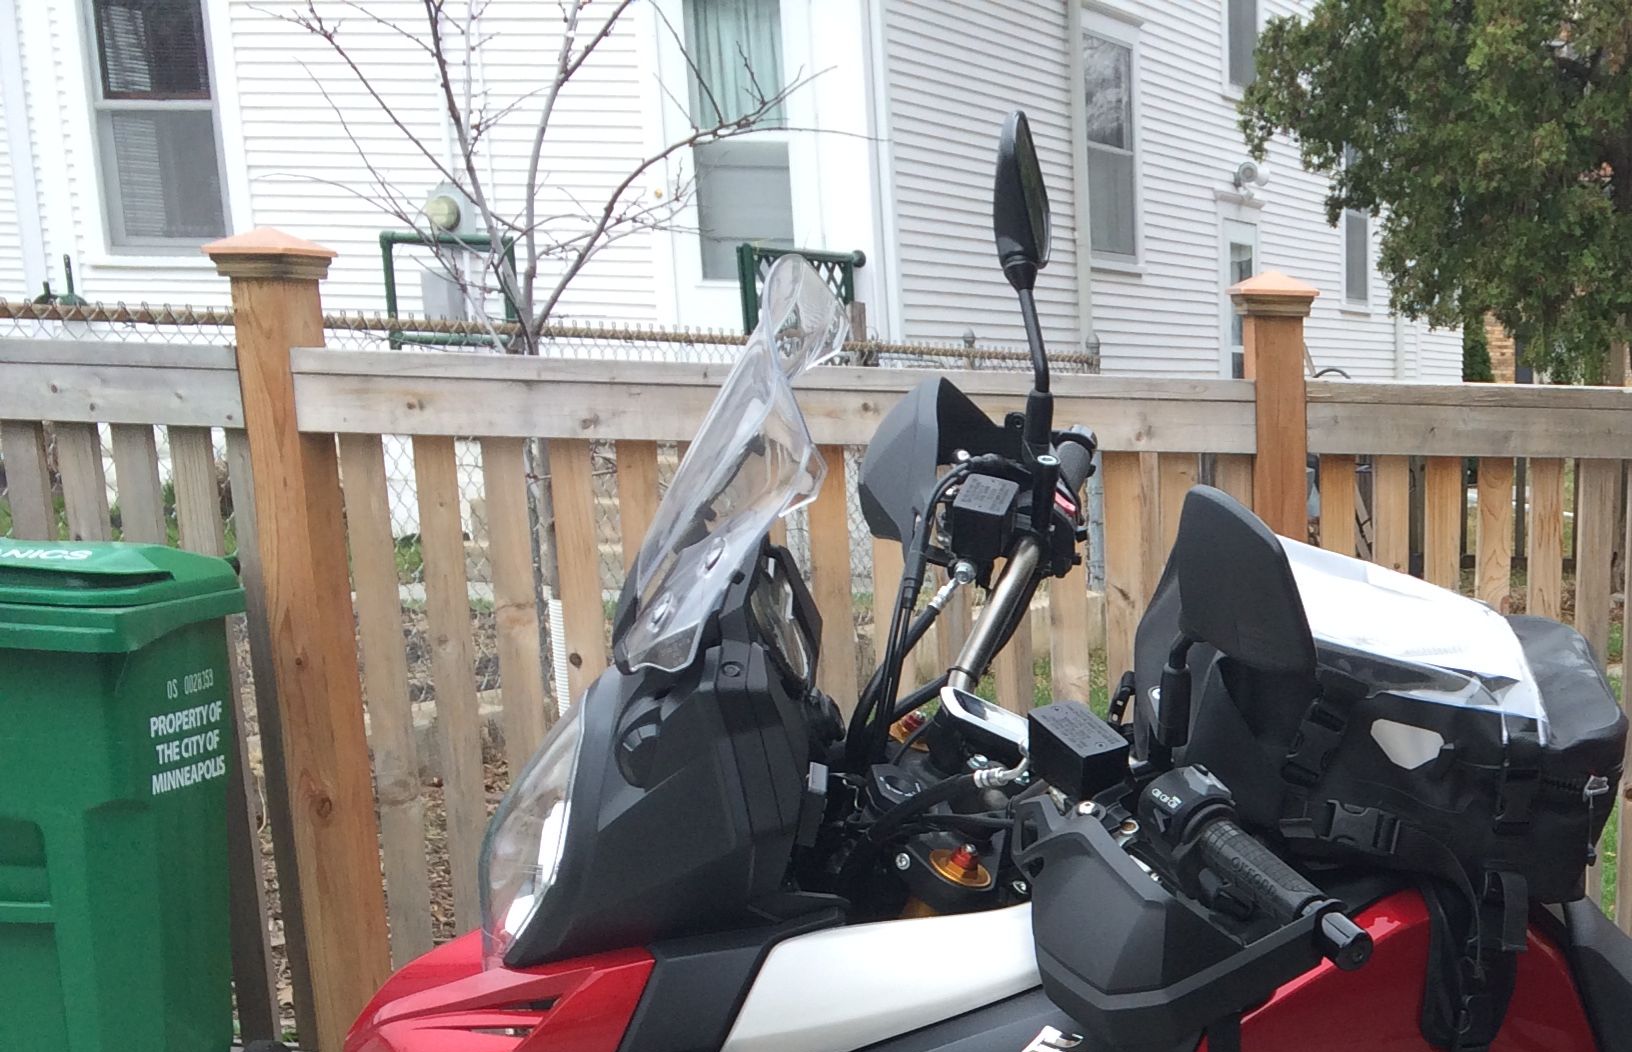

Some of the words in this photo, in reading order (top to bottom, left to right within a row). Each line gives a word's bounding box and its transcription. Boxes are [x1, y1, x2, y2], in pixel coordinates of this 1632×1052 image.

[150, 704, 208, 738] PROPERTY
[208, 700, 223, 723] OF
[155, 740, 180, 765] THE
[181, 733, 205, 758] CITY
[205, 729, 220, 752] OF
[152, 755, 226, 796] MINNEAPOLIS
